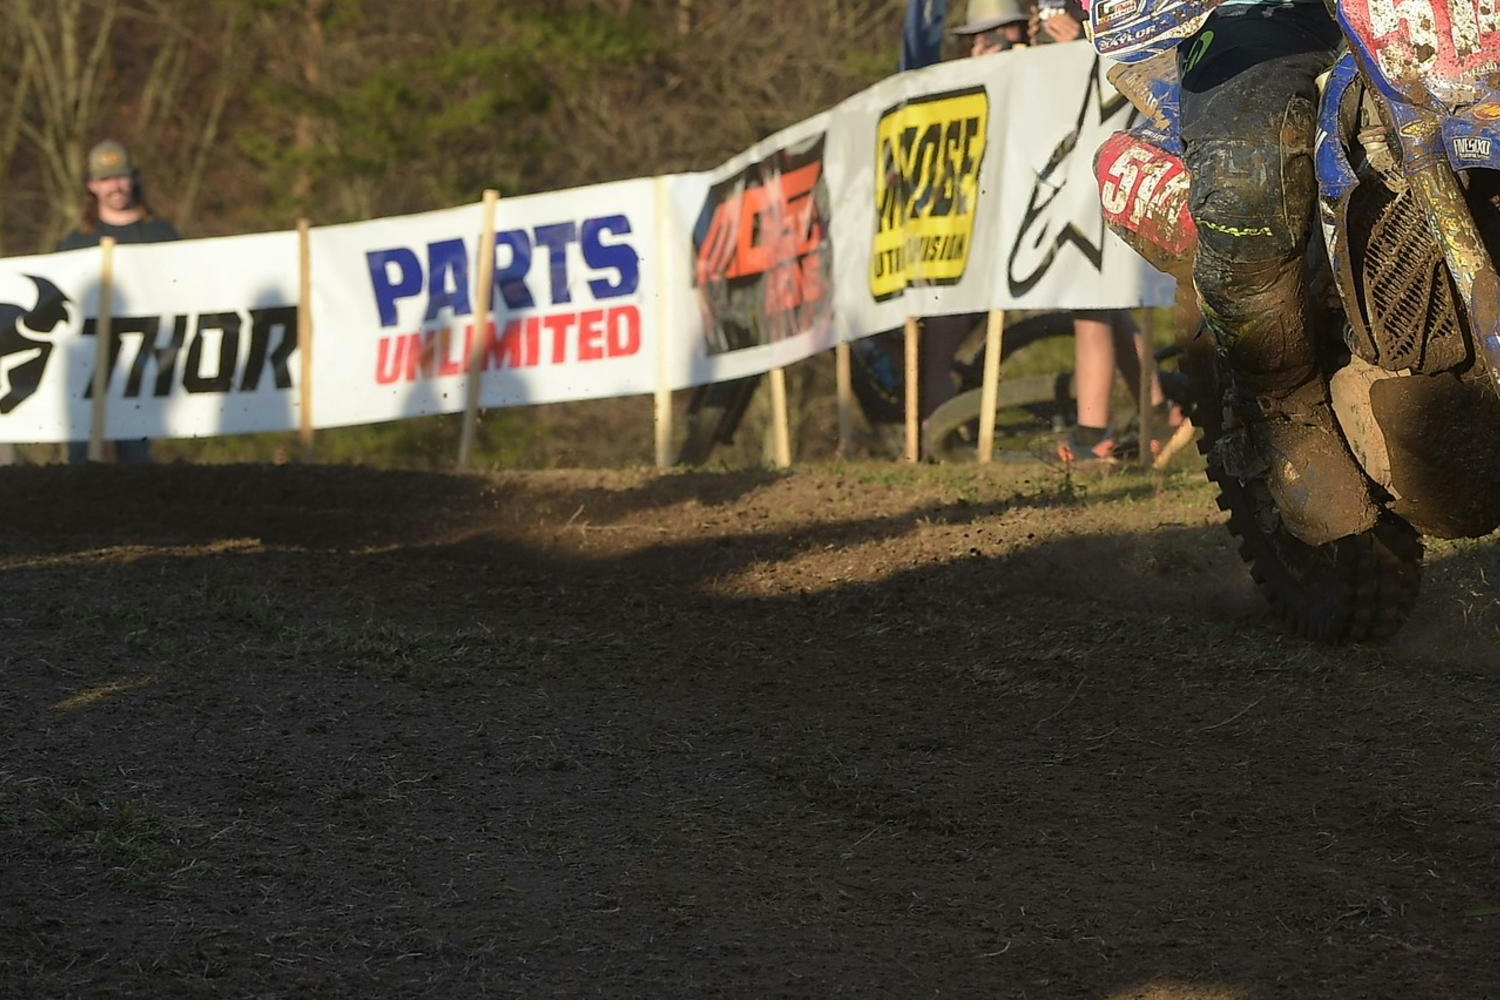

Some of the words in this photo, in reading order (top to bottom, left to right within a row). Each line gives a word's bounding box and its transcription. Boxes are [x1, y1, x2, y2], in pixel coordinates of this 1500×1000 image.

[365, 213, 640, 327] PARTS
[81, 305, 298, 398] THOR
[375, 304, 642, 385] UNLIMITED
